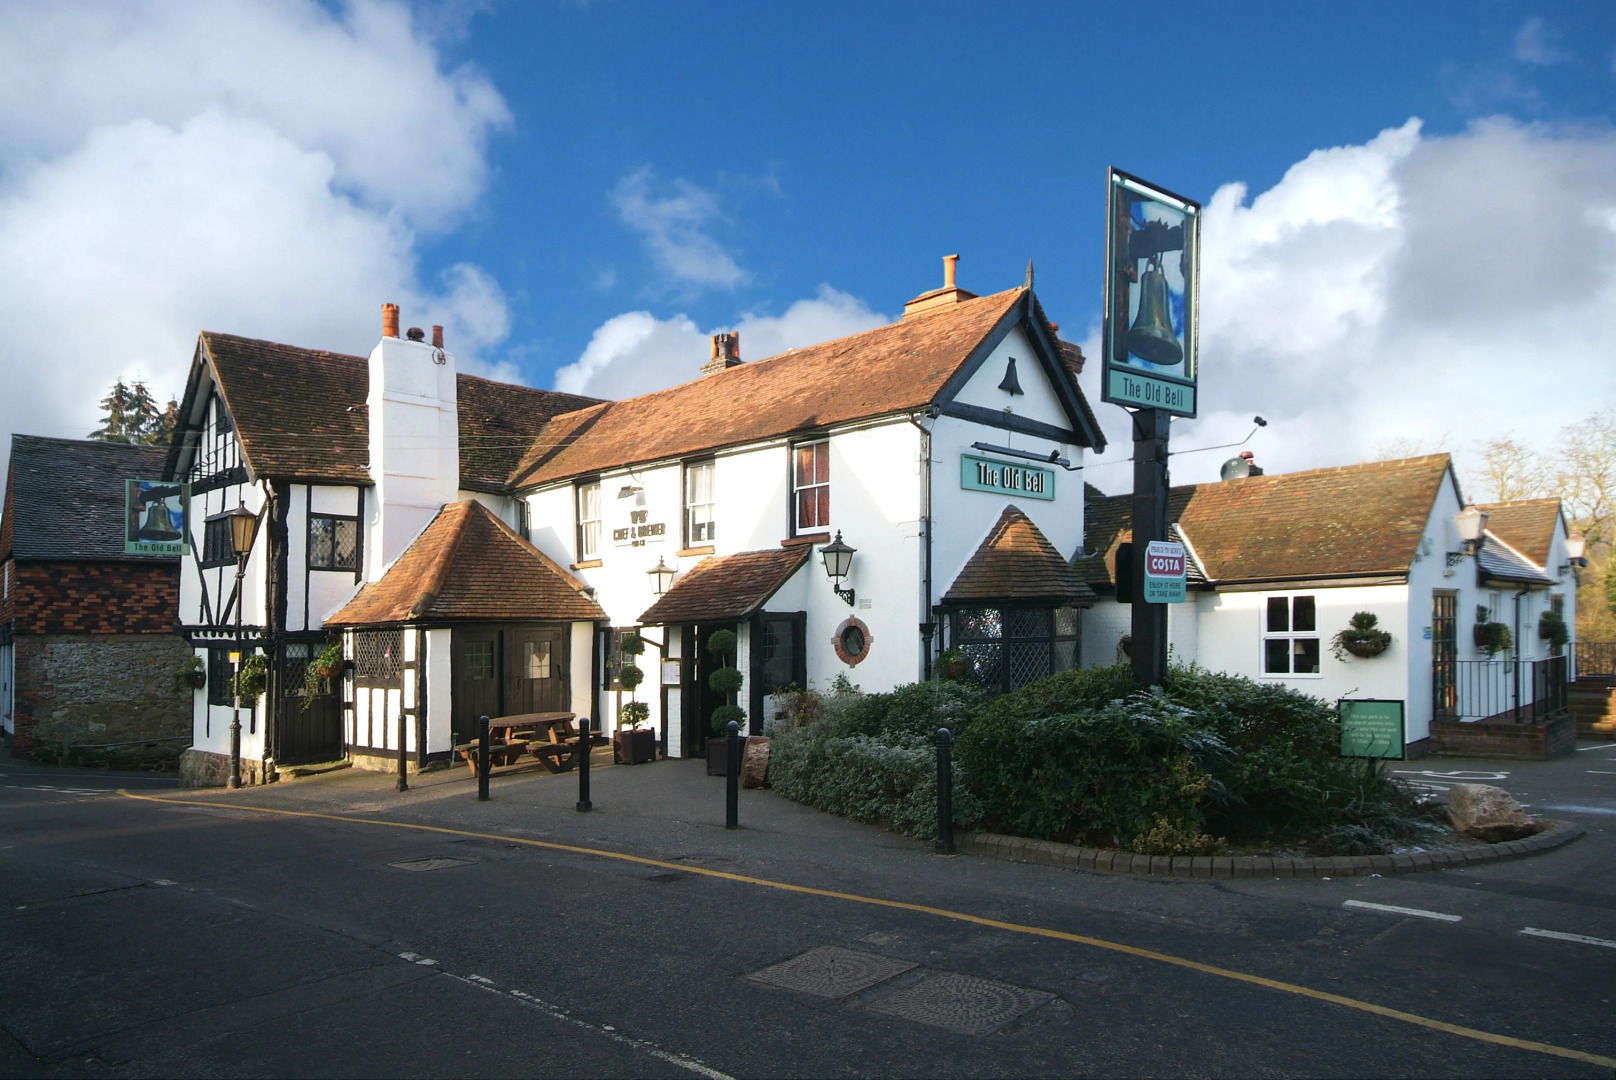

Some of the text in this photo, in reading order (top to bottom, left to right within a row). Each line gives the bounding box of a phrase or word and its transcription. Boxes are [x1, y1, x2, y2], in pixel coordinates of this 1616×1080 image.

[1123, 377, 1183, 407] The Old Bell
[977, 462, 1045, 493] The Old Bell
[613, 522, 666, 541] CHEF & BREWER
[134, 542, 182, 552] The Old Bell
[1152, 558, 1180, 572] COSTA
